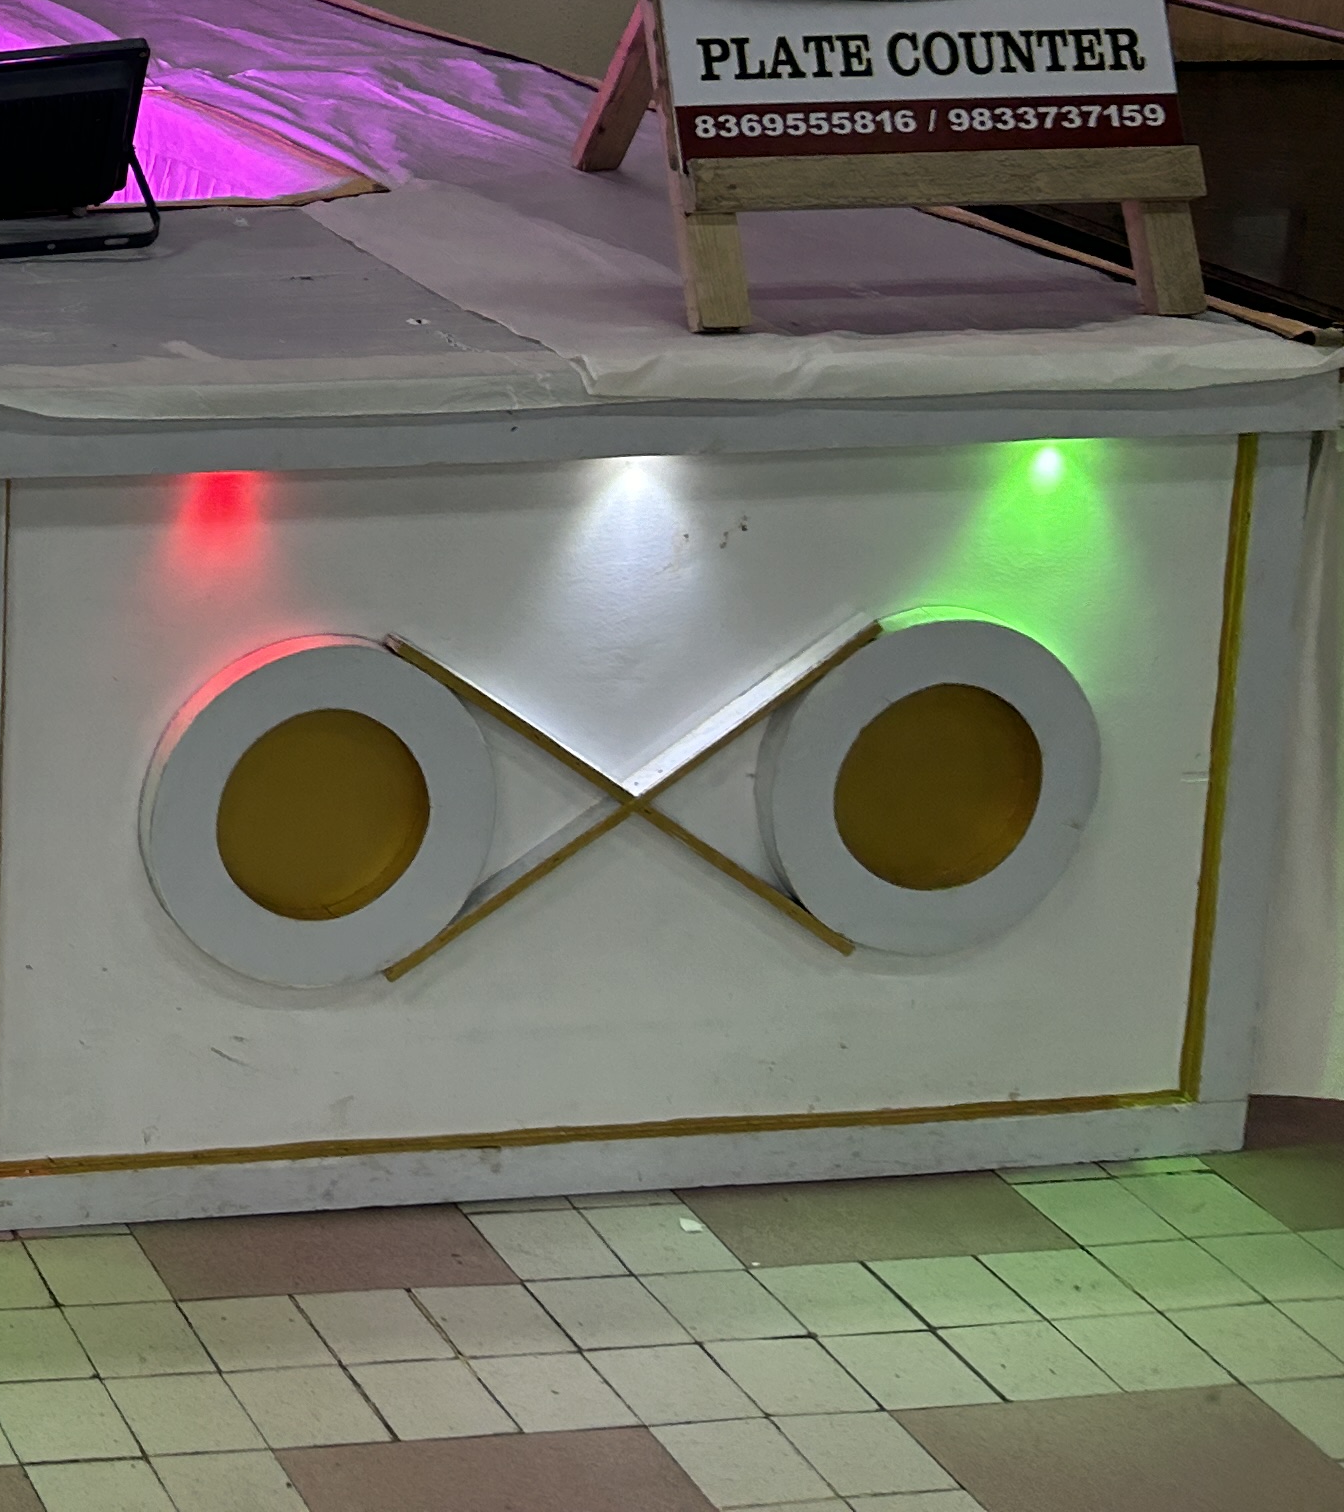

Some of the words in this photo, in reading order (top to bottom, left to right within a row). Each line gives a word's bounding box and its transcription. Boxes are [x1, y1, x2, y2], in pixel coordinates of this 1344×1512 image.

[696, 33, 874, 81] PLATE
[886, 27, 1146, 76] COUNTER
[694, 108, 917, 139] 8369555816
[947, 102, 1167, 133] 9833737159
